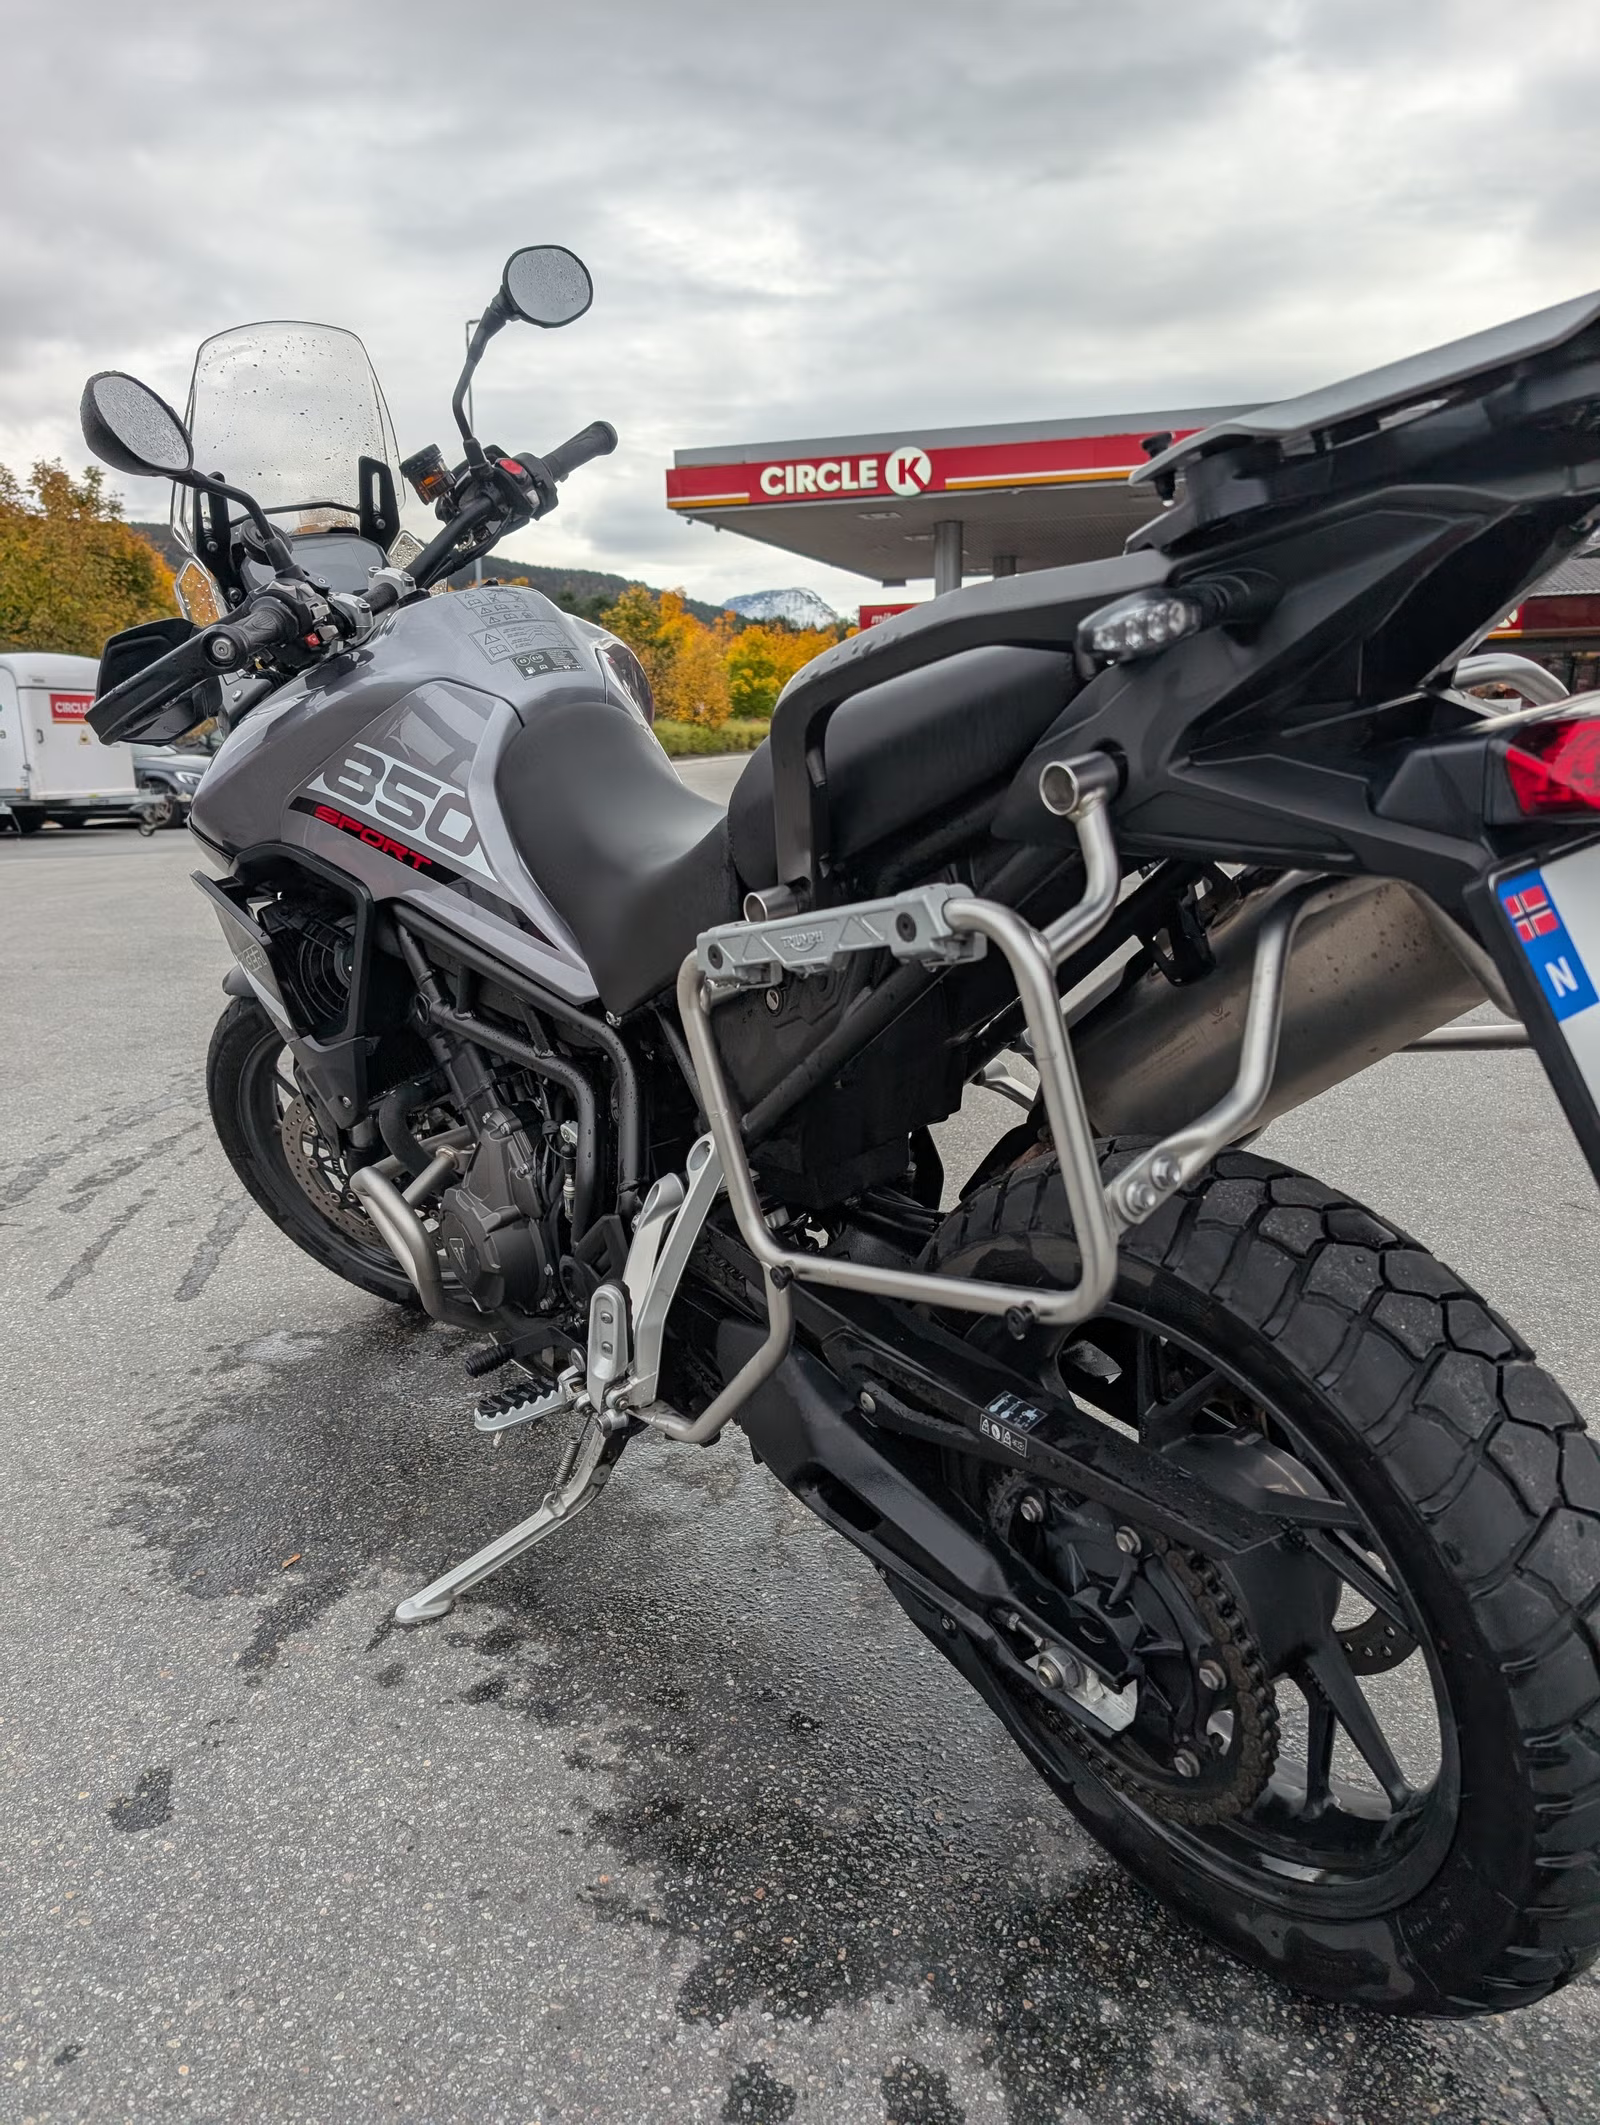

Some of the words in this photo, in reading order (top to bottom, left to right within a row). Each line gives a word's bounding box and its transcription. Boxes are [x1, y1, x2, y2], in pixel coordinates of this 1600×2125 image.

[760, 459, 878, 495] CIRCLE
[318, 742, 482, 860] 850
[314, 804, 432, 870] SPORT
[1545, 956, 1579, 997] N
